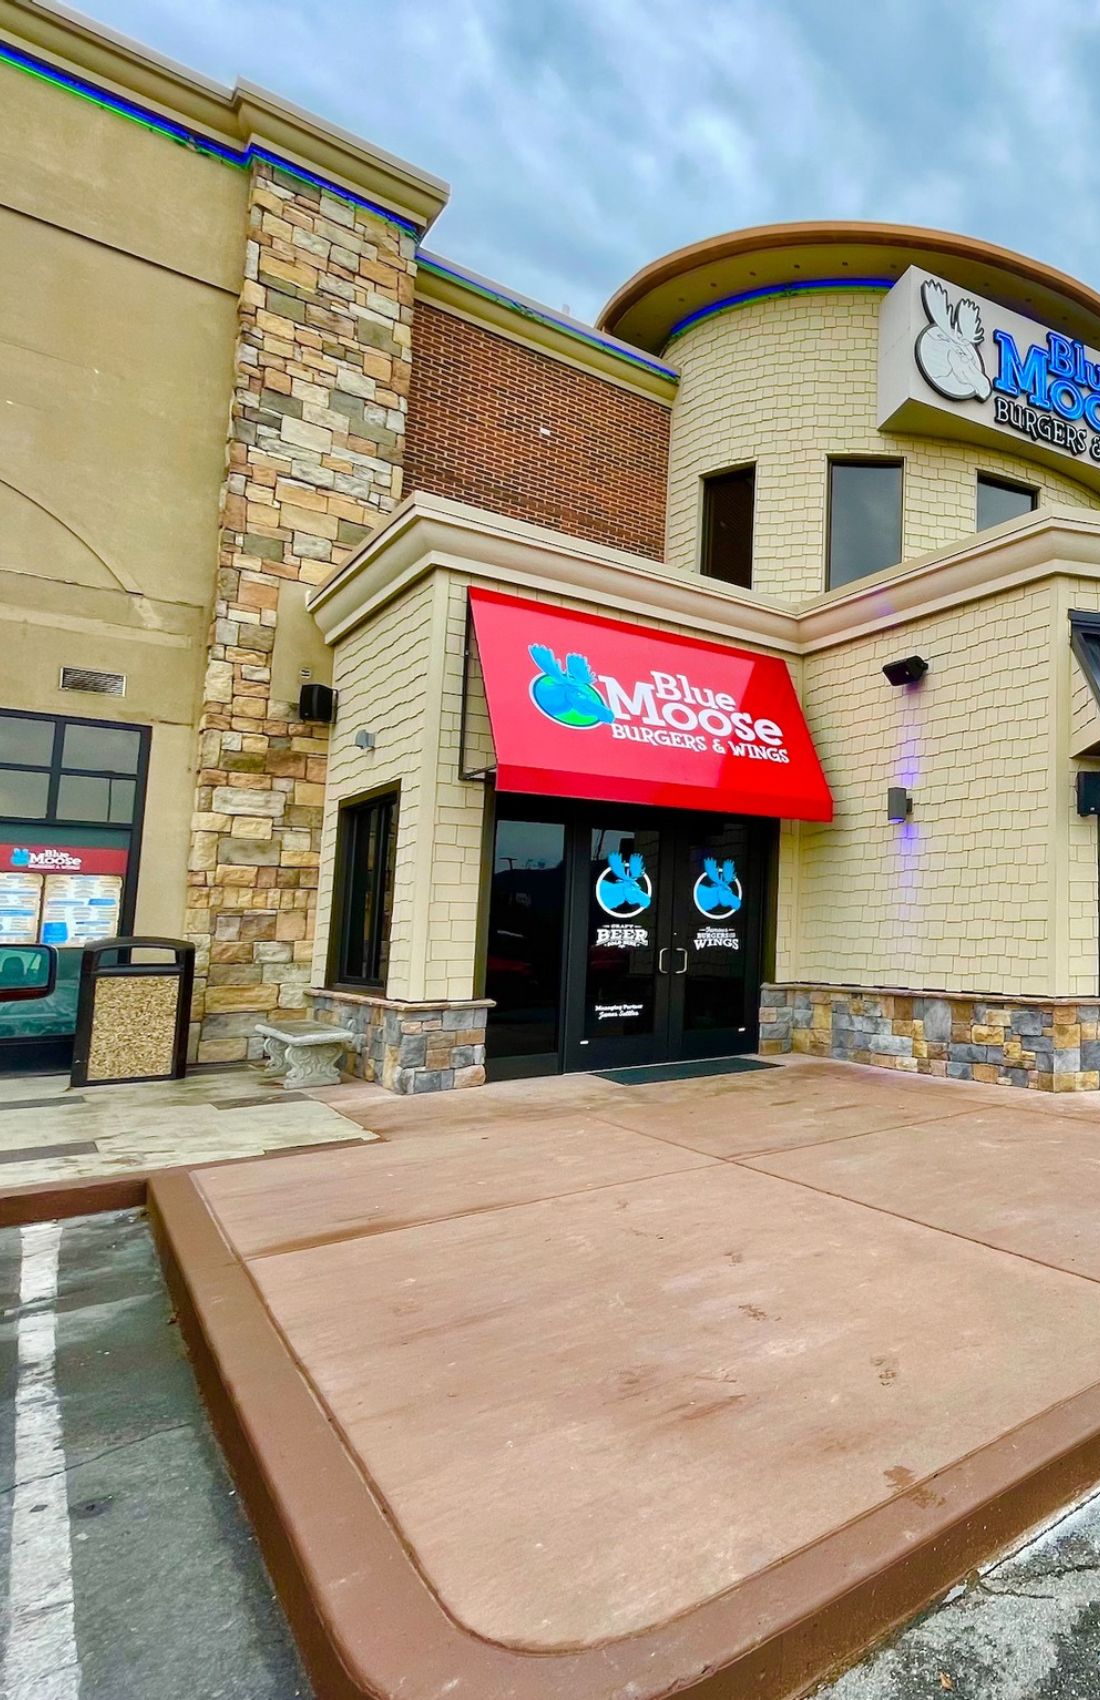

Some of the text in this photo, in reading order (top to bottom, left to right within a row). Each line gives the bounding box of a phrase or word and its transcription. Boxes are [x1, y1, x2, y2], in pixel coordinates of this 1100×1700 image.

[994, 397, 1088, 456] BURGERS
[650, 671, 736, 713] Blue
[611, 723, 790, 764] BURGERS & WINGS
[44, 849, 70, 859] Blue
[596, 928, 649, 947] BEER
[693, 938, 740, 951] WINGS
